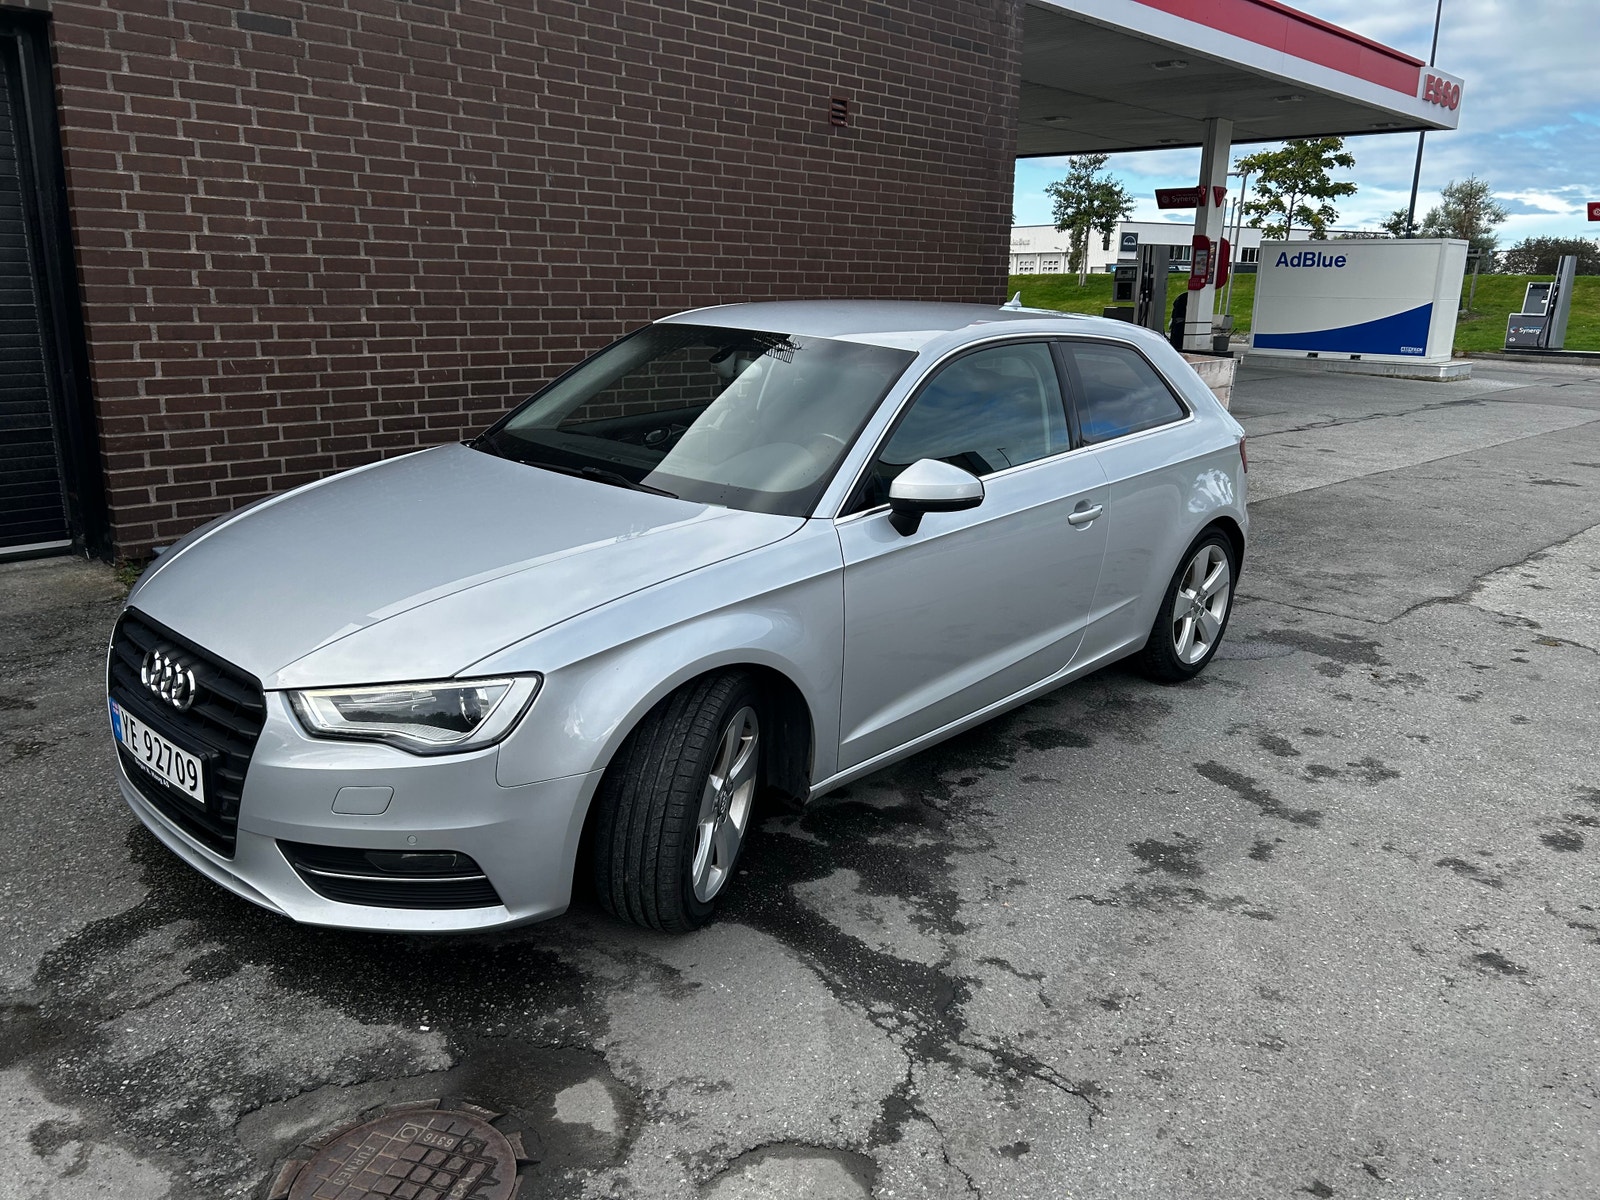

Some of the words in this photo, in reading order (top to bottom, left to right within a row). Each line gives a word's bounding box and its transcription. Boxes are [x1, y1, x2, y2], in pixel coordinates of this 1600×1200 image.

[1422, 73, 1460, 111] ESSO
[1275, 251, 1347, 268] AdBlue
[144, 730, 198, 792] 92709
[422, 1131, 453, 1148] 6316
[333, 1145, 376, 1186] FURNES
